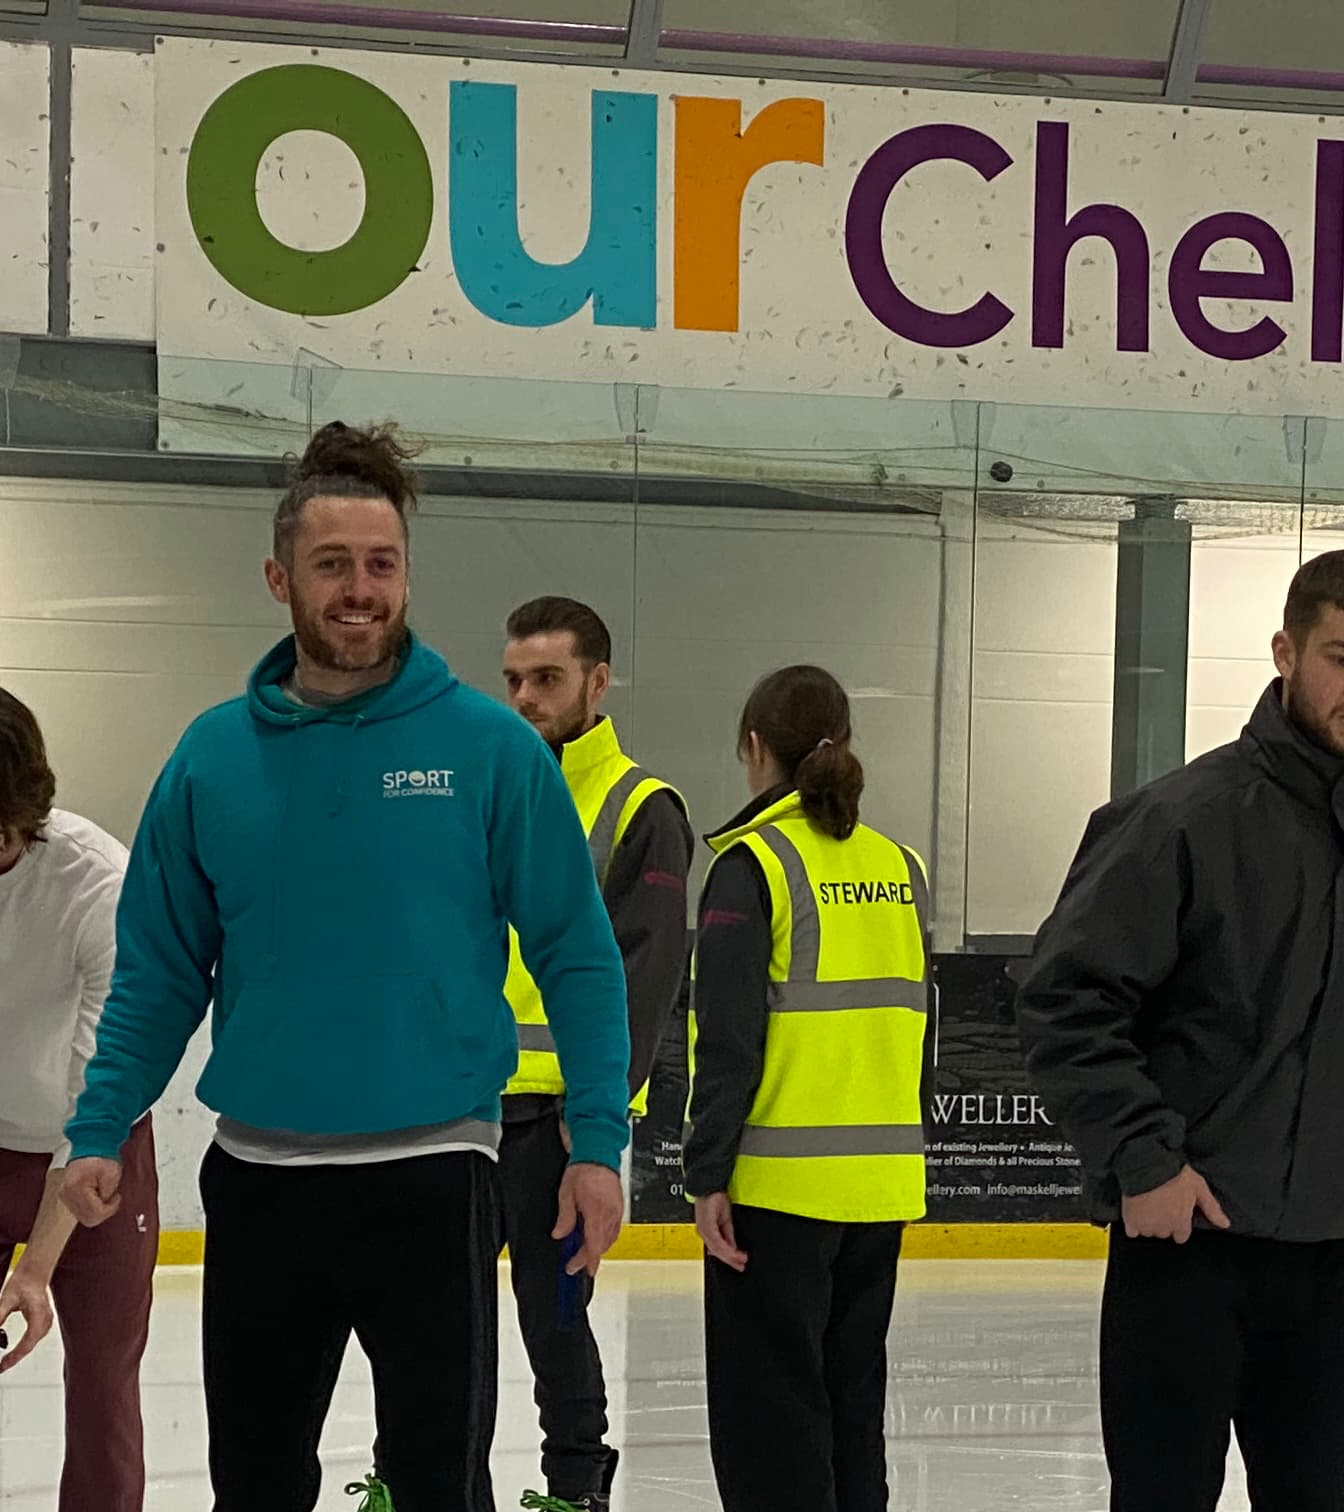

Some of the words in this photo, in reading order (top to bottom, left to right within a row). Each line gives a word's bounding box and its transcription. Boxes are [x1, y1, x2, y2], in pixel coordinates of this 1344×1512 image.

[186, 64, 824, 332] our
[383, 770, 454, 788] SPORT
[819, 881, 914, 905] STEWARD
[930, 1095, 1055, 1126] WELLER
[1055, 1156, 1081, 1166] Stone
[670, 1184, 683, 1195] 01
[926, 1184, 981, 1198] ellery.com
